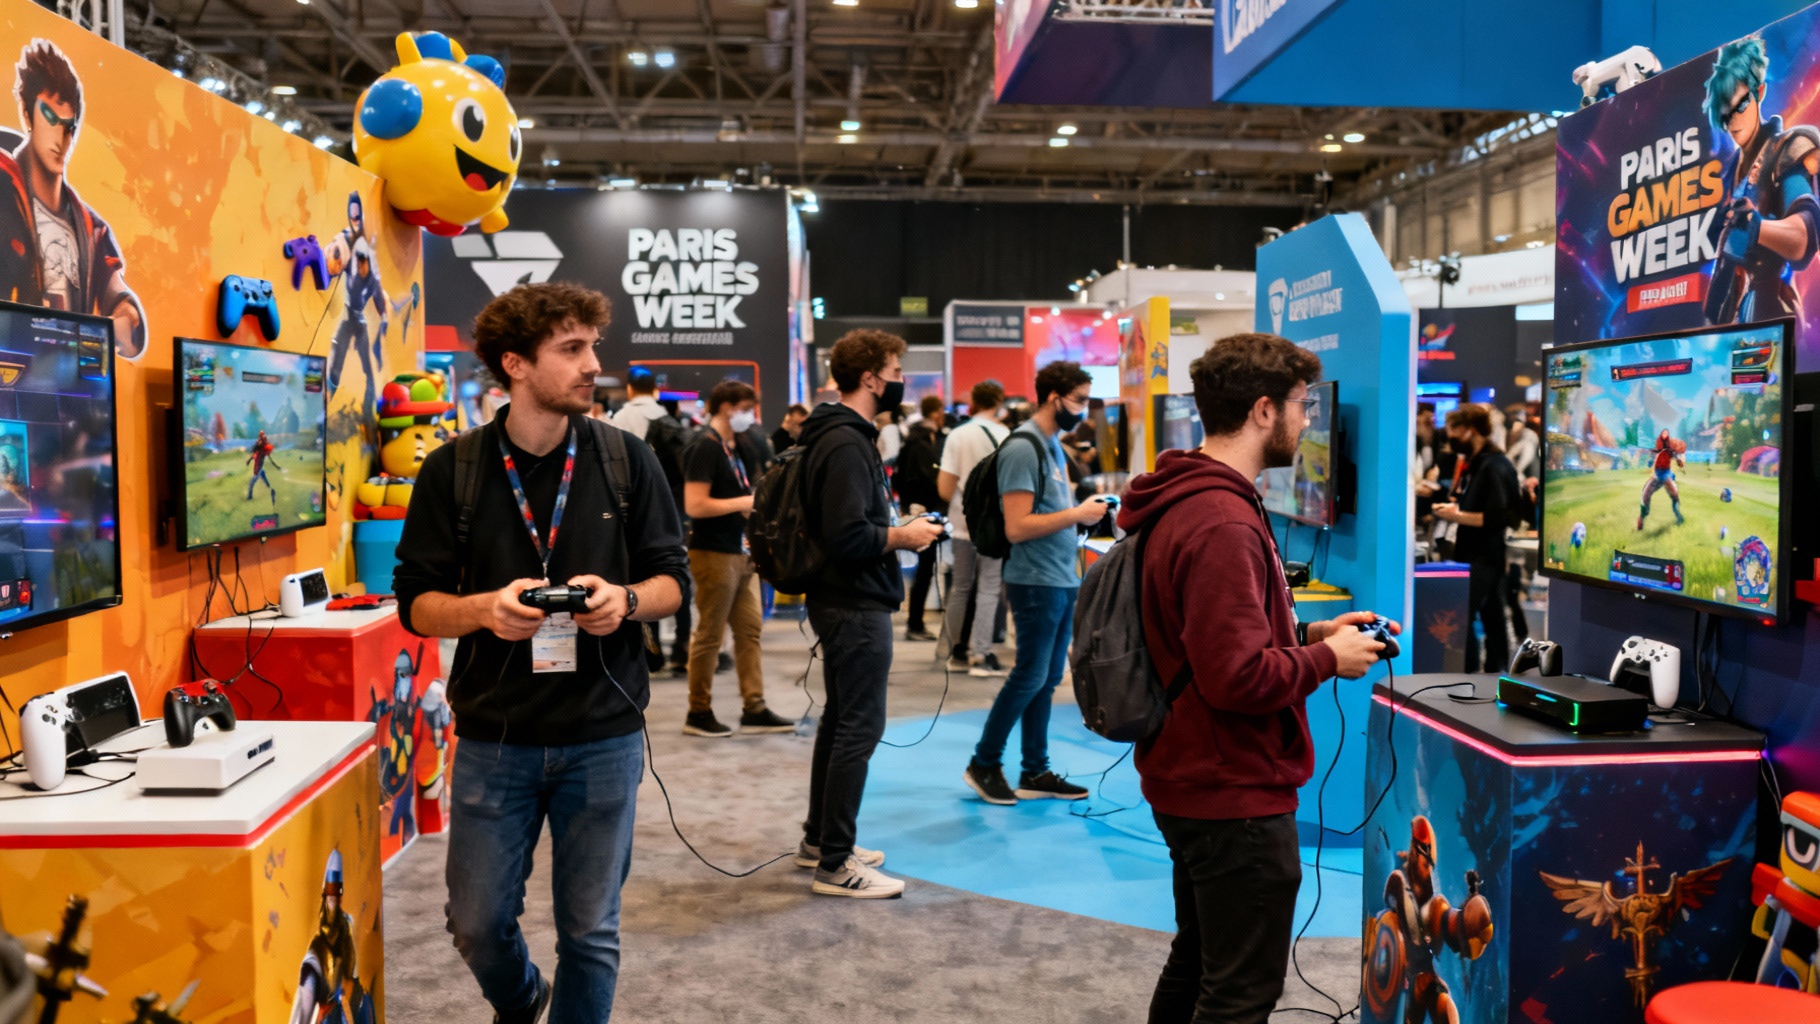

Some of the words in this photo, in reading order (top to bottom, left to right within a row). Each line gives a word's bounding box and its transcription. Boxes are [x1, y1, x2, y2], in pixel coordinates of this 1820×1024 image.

[1621, 127, 1700, 190] PARIS
[1607, 160, 1724, 238] GAMES
[628, 228, 739, 261] PARIS
[1610, 207, 1718, 284] WEEK
[621, 261, 760, 295] GAMES
[632, 294, 747, 328] WEEK
